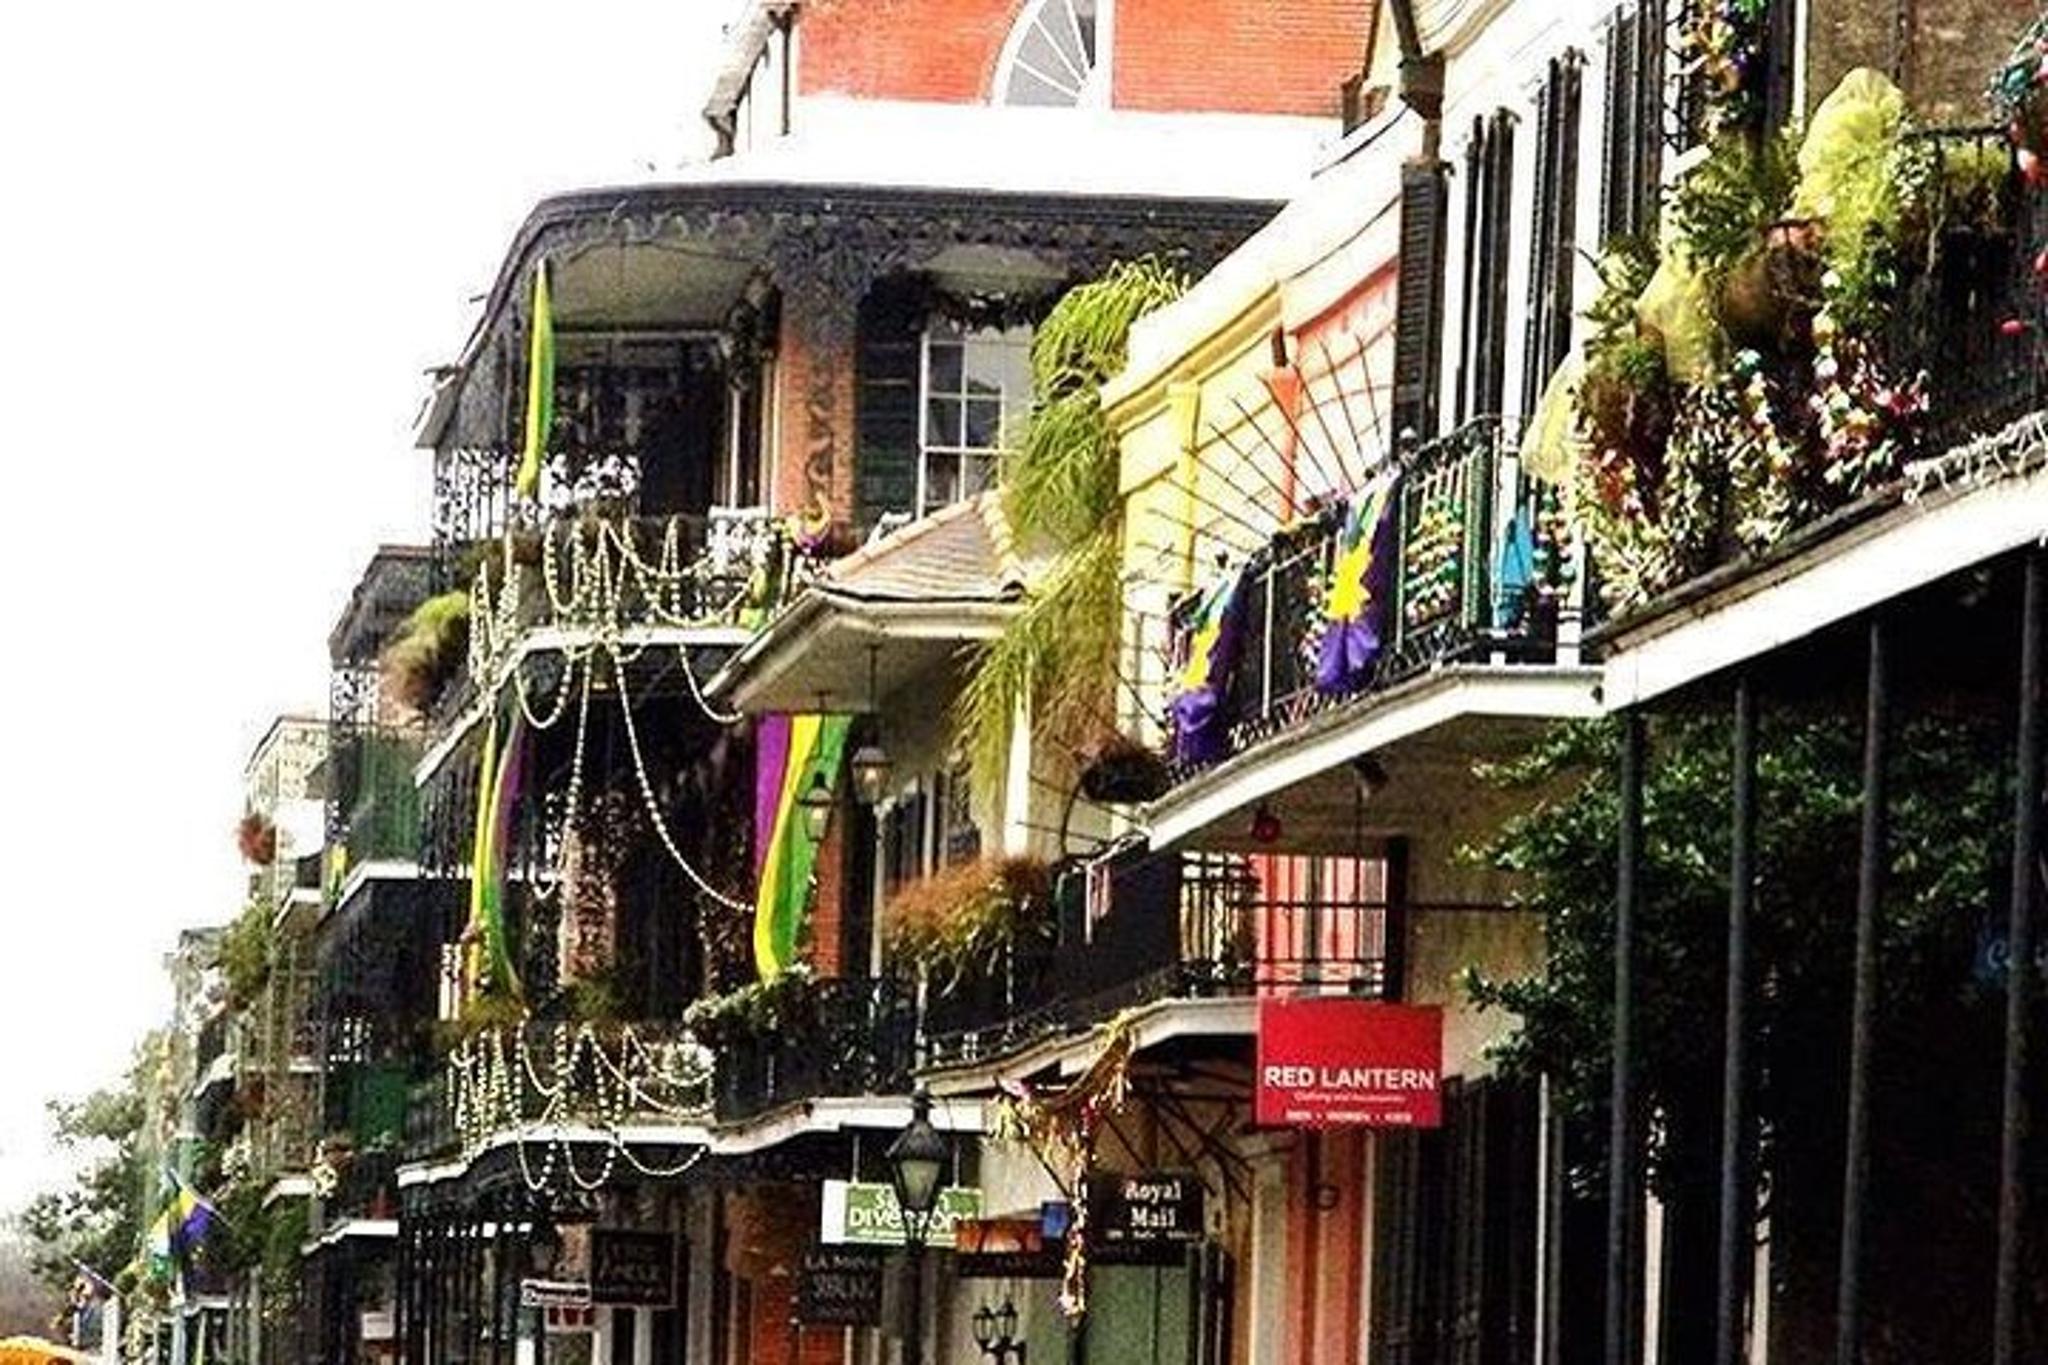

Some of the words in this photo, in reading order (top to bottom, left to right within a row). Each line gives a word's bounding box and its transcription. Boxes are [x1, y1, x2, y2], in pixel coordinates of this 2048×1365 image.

[1264, 1066, 1314, 1087] RED
[1321, 1067, 1435, 1090] LANTERN
[1125, 1180, 1181, 1205] Royal
[1130, 1206, 1176, 1227] Mail
